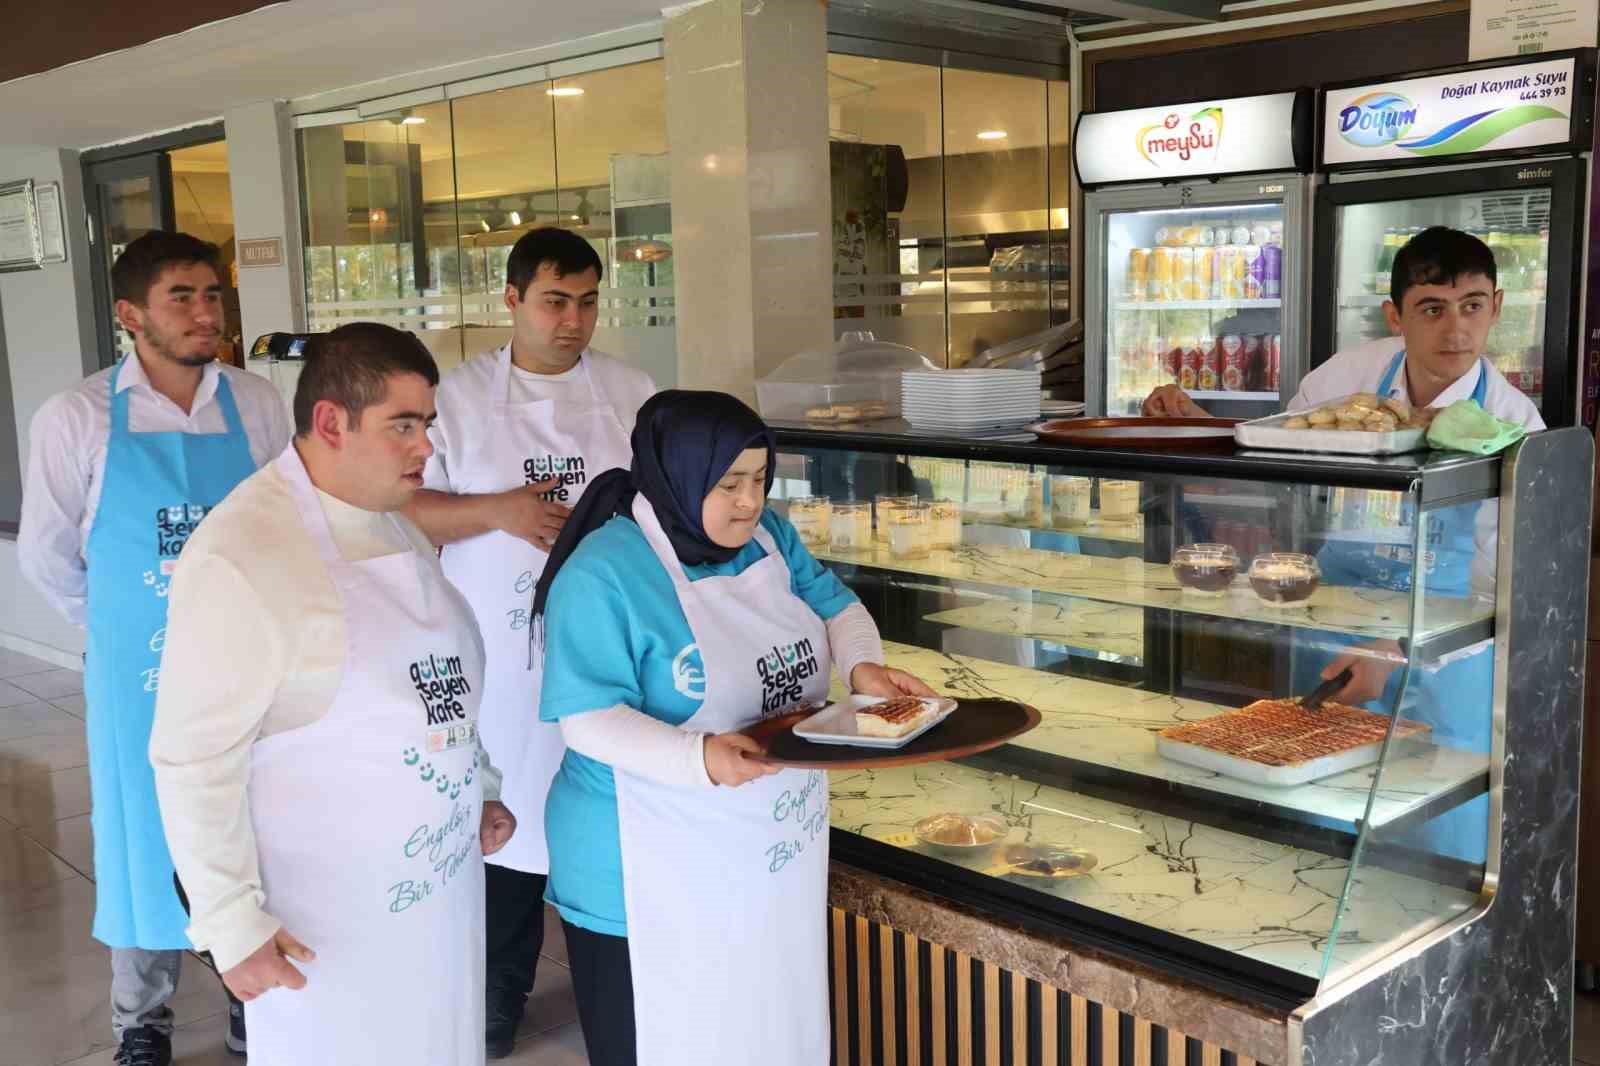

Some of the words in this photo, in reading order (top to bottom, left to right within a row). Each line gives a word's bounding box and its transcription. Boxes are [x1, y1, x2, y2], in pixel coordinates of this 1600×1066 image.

[1441, 83, 1477, 99] Doğal
[1480, 75, 1531, 94] Kaynak
[1533, 71, 1568, 87] Suyu
[1520, 90, 1538, 101] 444
[1540, 88, 1552, 98] 39
[1554, 86, 1566, 96] 93
[1339, 105, 1418, 137] Doyum
[523, 454, 585, 479] gülüm
[409, 654, 463, 690] gülüm
[756, 637, 814, 684] gülüm
[764, 656, 818, 693] seyen
[420, 676, 471, 702] seyen
[761, 684, 803, 713] kafe
[419, 692, 466, 725] kafe
[765, 840, 805, 873] Bir
[387, 880, 433, 912] Bir
